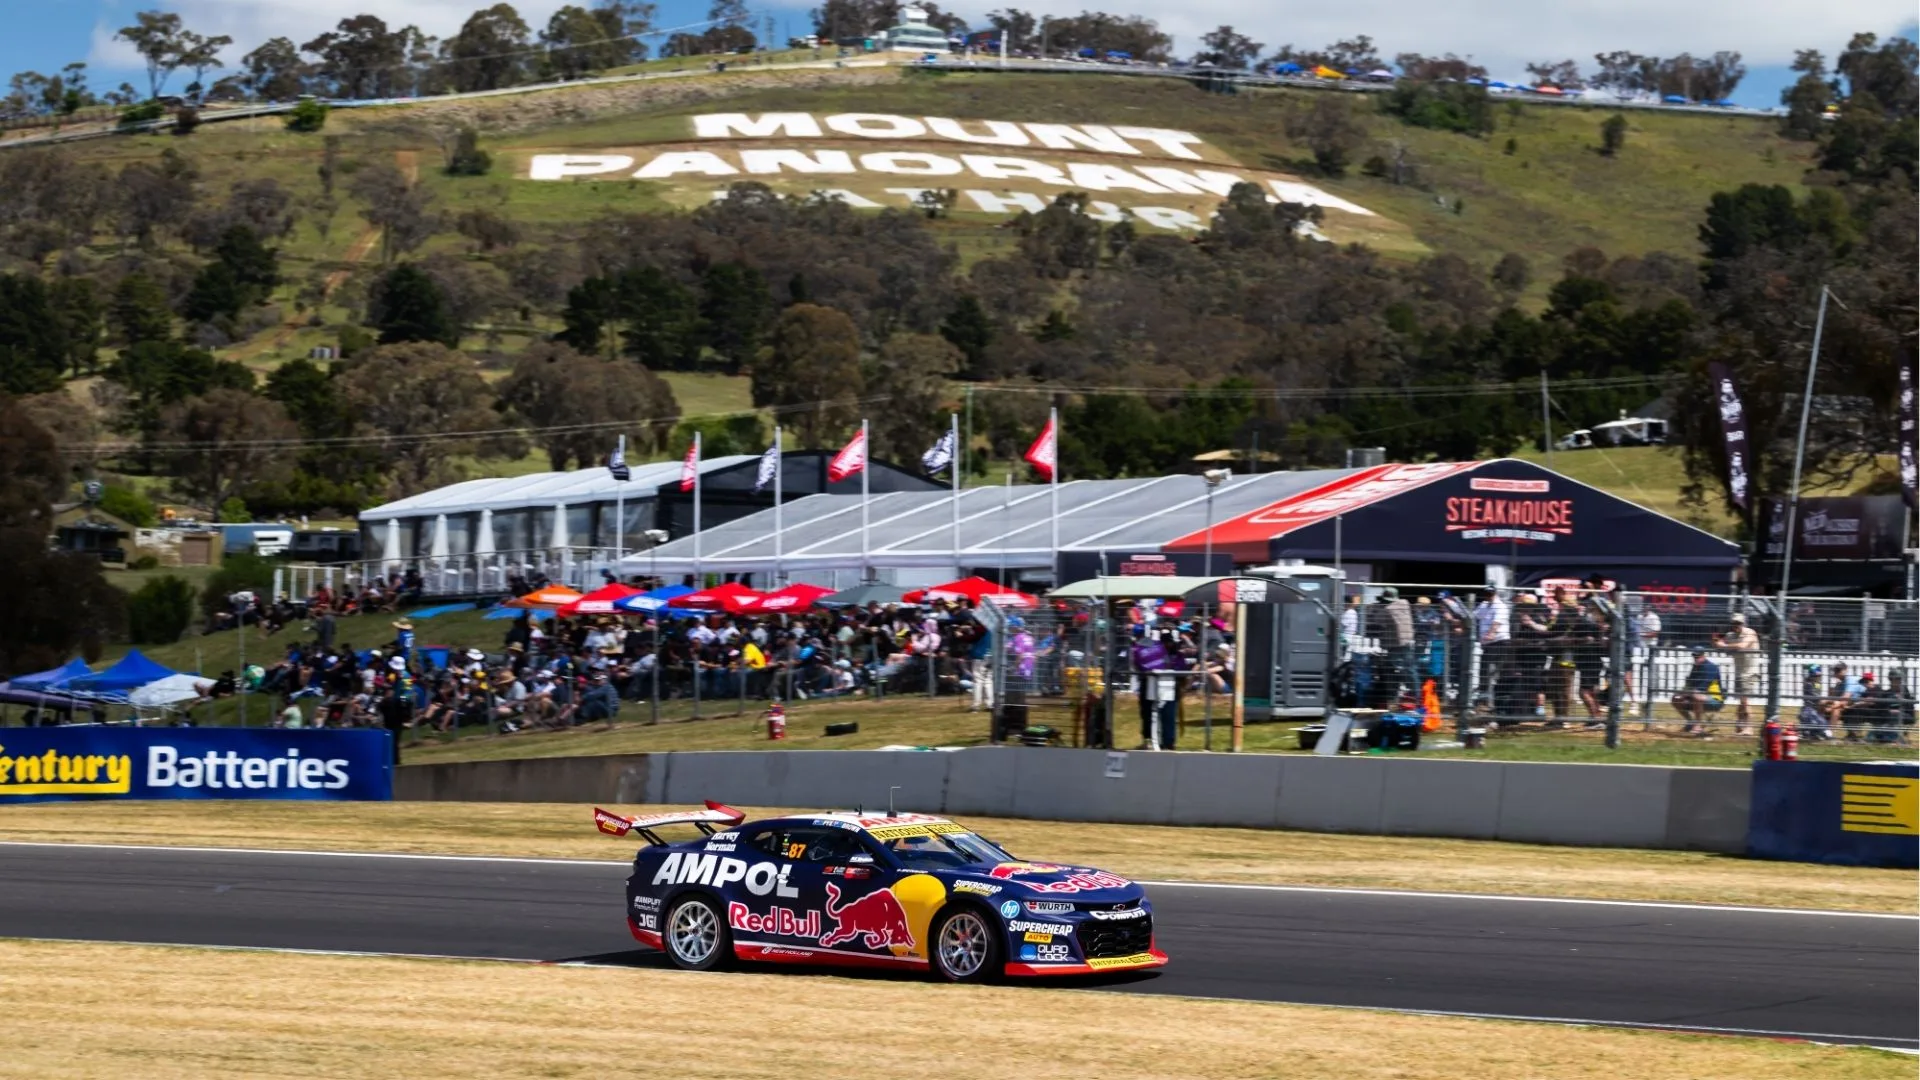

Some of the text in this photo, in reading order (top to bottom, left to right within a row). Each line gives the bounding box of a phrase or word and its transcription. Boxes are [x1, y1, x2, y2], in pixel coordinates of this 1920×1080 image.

[693, 112, 1204, 161] MOUNT
[530, 149, 1377, 216] PANORAMA
[1446, 498, 1573, 525] STEAKHOUSE
[0, 744, 349, 793] entury Batteries
[711, 832, 740, 842] Harvey
[704, 842, 736, 852] Norman
[789, 843, 807, 859] 87
[652, 852, 799, 899] AMPOL
[953, 880, 1003, 894] SUPERCHEAP
[1003, 901, 1018, 918] hp
[1008, 920, 1074, 937] SUPERCHEAP
[1037, 944, 1069, 954] QUAD
[1037, 953, 1069, 961] LOCK
